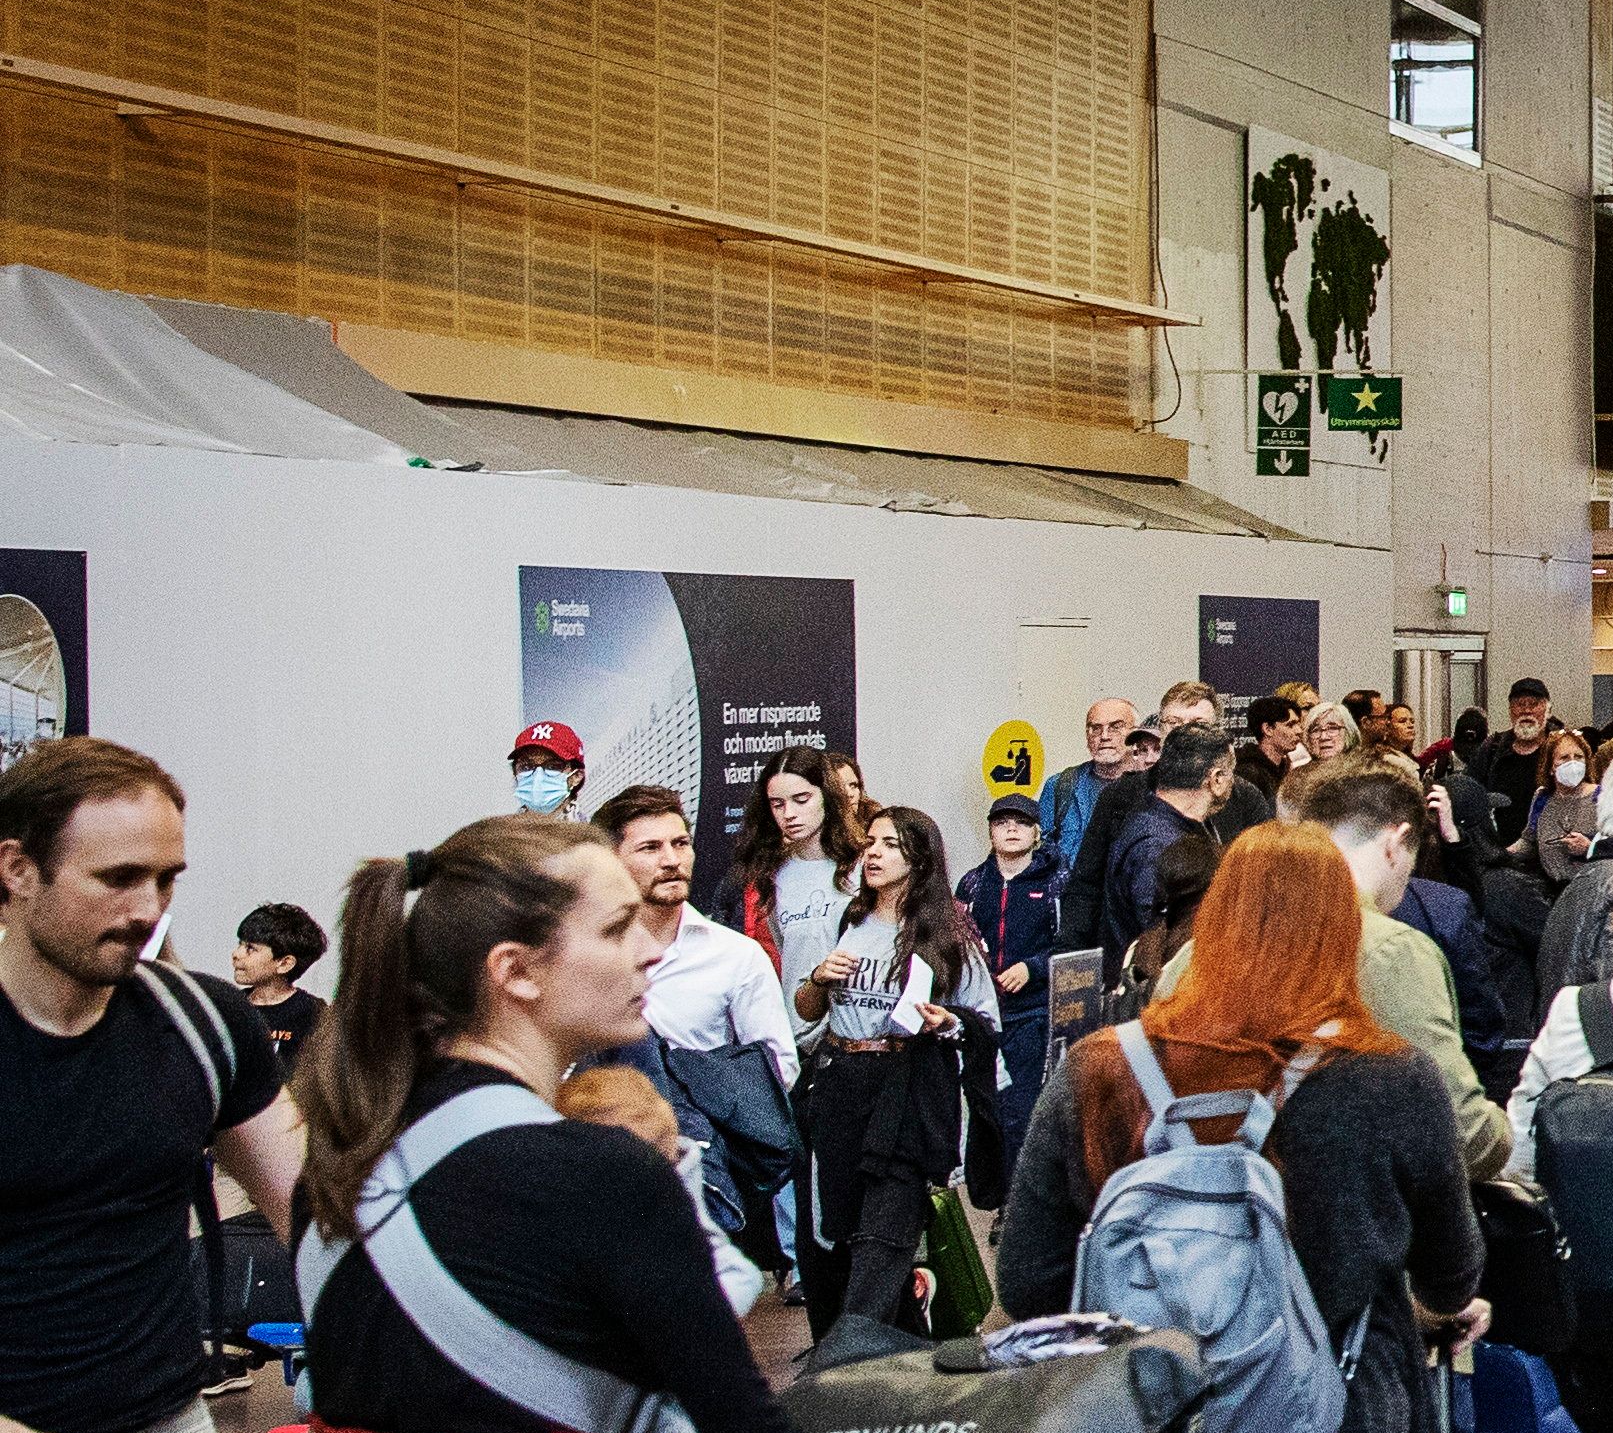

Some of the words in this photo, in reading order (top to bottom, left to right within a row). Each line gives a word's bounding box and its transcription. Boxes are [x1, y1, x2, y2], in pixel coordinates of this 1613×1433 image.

[1271, 430, 1298, 439] AED
[552, 619, 585, 640] Airports
[723, 702, 738, 724] En
[739, 707, 759, 724] mer
[760, 701, 821, 728] inspirerande
[724, 732, 743, 754] och
[745, 731, 783, 753] modern
[724, 762, 753, 784] växer
[780, 905, 811, 926] Good
